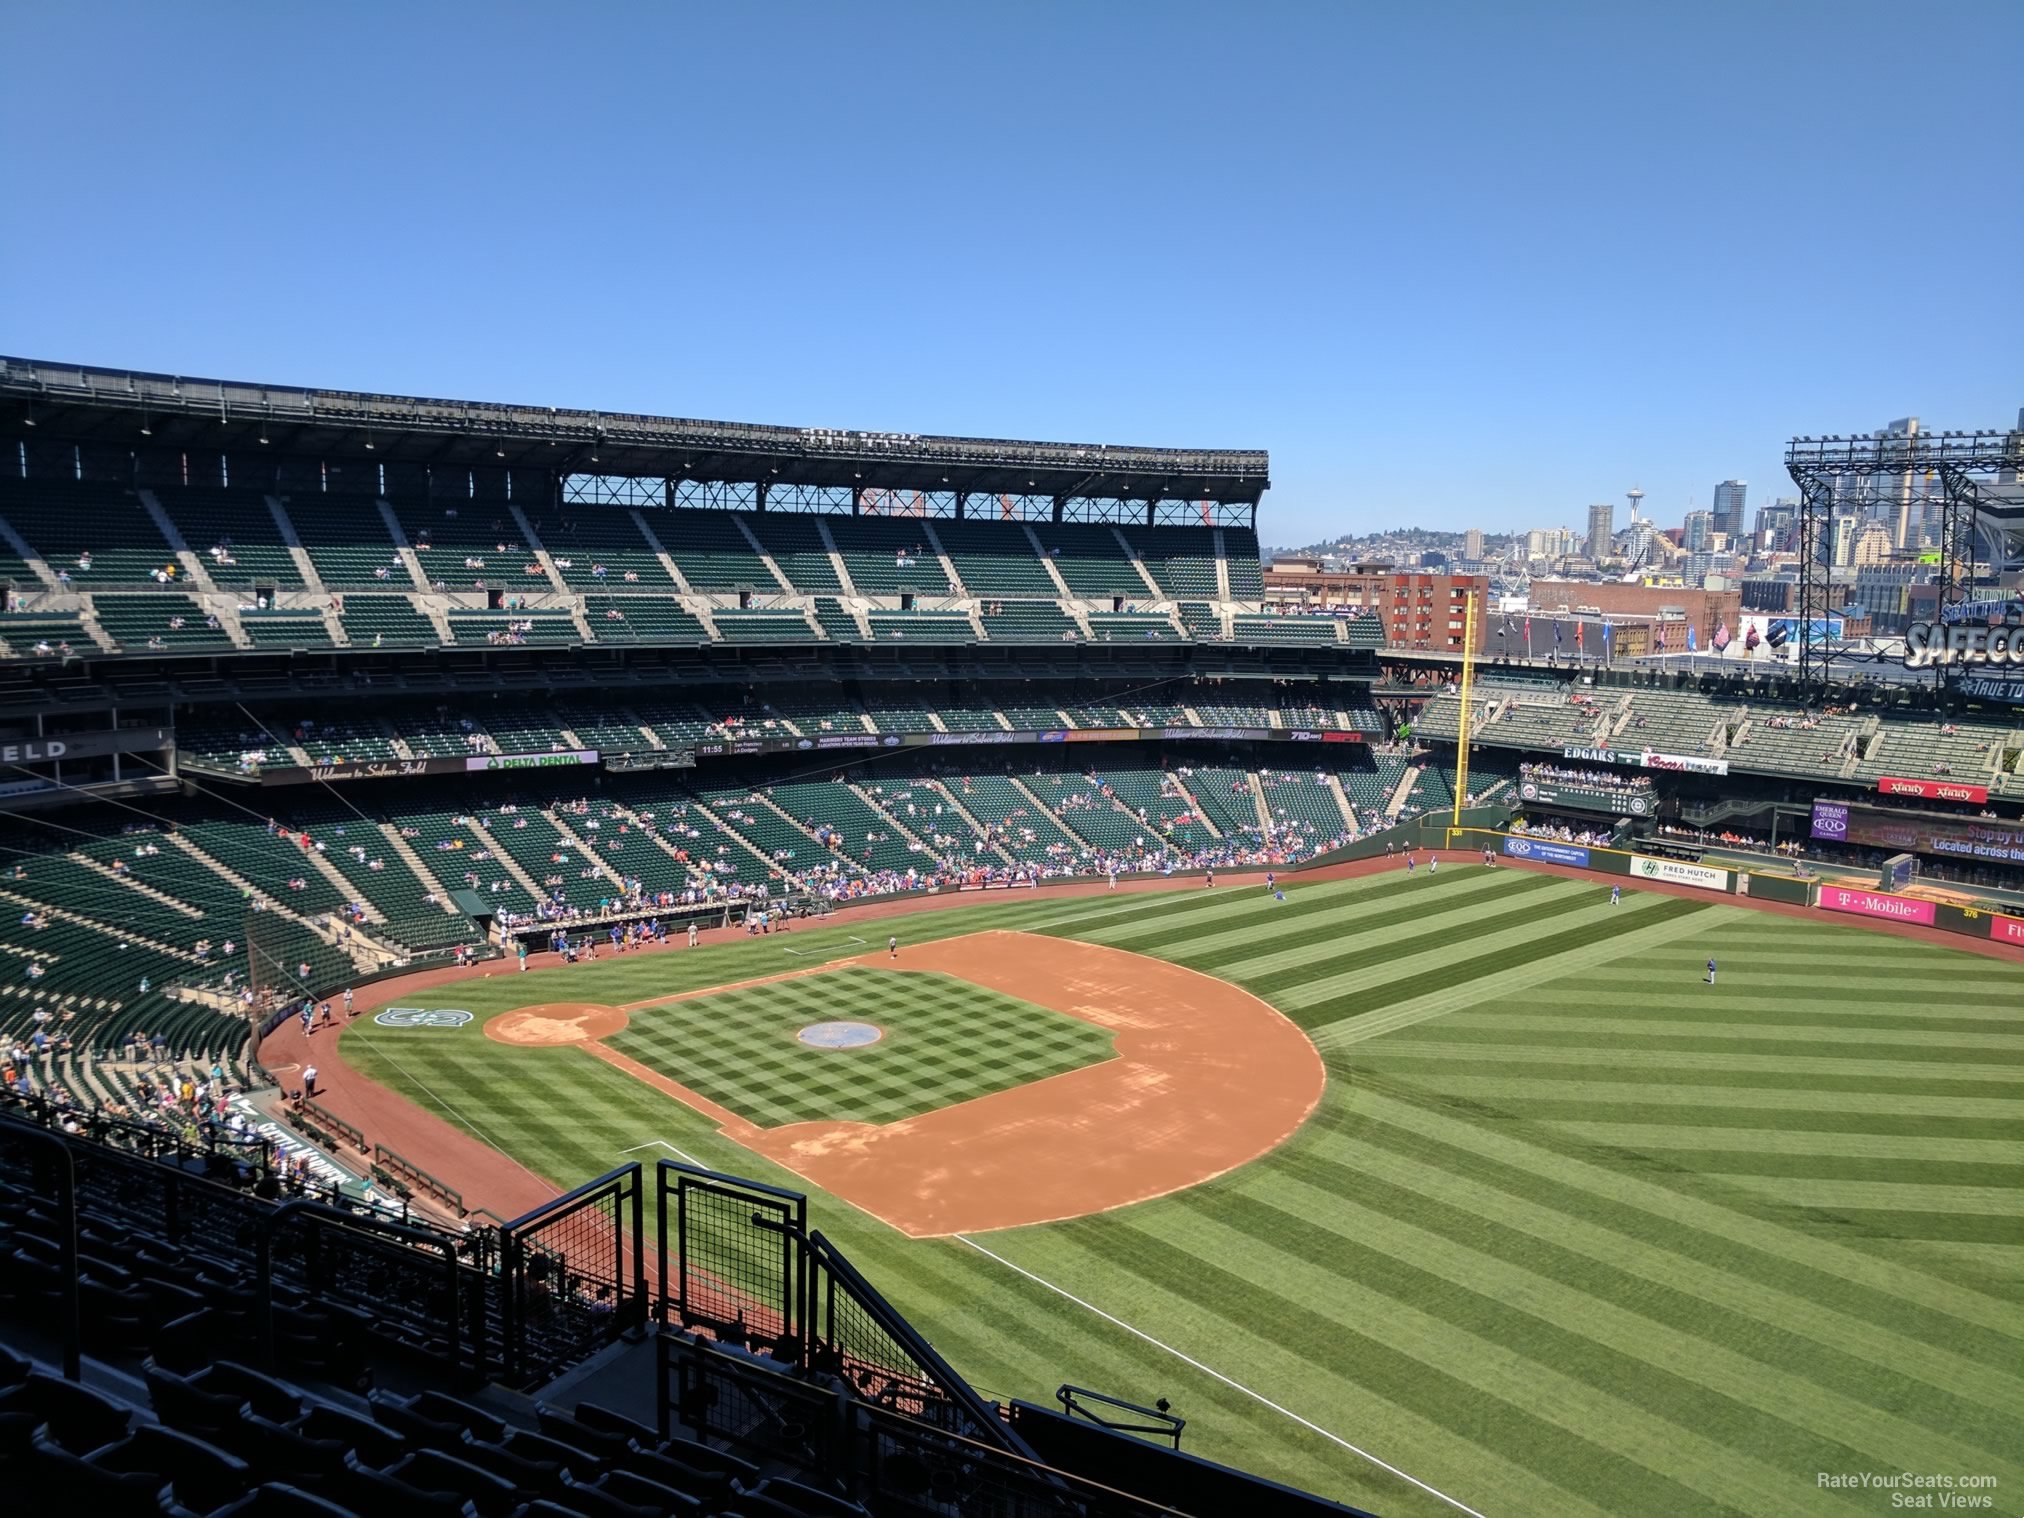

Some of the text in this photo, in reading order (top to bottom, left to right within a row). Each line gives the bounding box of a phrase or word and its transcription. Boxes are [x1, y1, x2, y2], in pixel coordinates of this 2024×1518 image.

[1973, 678, 2007, 697] TRUE
[702, 745, 722, 754] 11:55
[503, 755, 582, 769] DELTA DENTAL
[1647, 755, 1684, 771] Coors
[310, 761, 428, 780] Welcome to Safeco Field
[1890, 782, 1972, 800] xfinity xfinity
[1815, 805, 1848, 814] EMERALD
[1820, 811, 1842, 819] QUEEN
[1813, 818, 1847, 832] EQC
[1968, 825, 1994, 842] Stop
[1997, 831, 2011, 845] by
[1974, 846, 2008, 858] across
[1663, 865, 1716, 879] FRED HUTCH
[1963, 909, 1978, 918] 376
[2008, 923, 2024, 938] Fl
